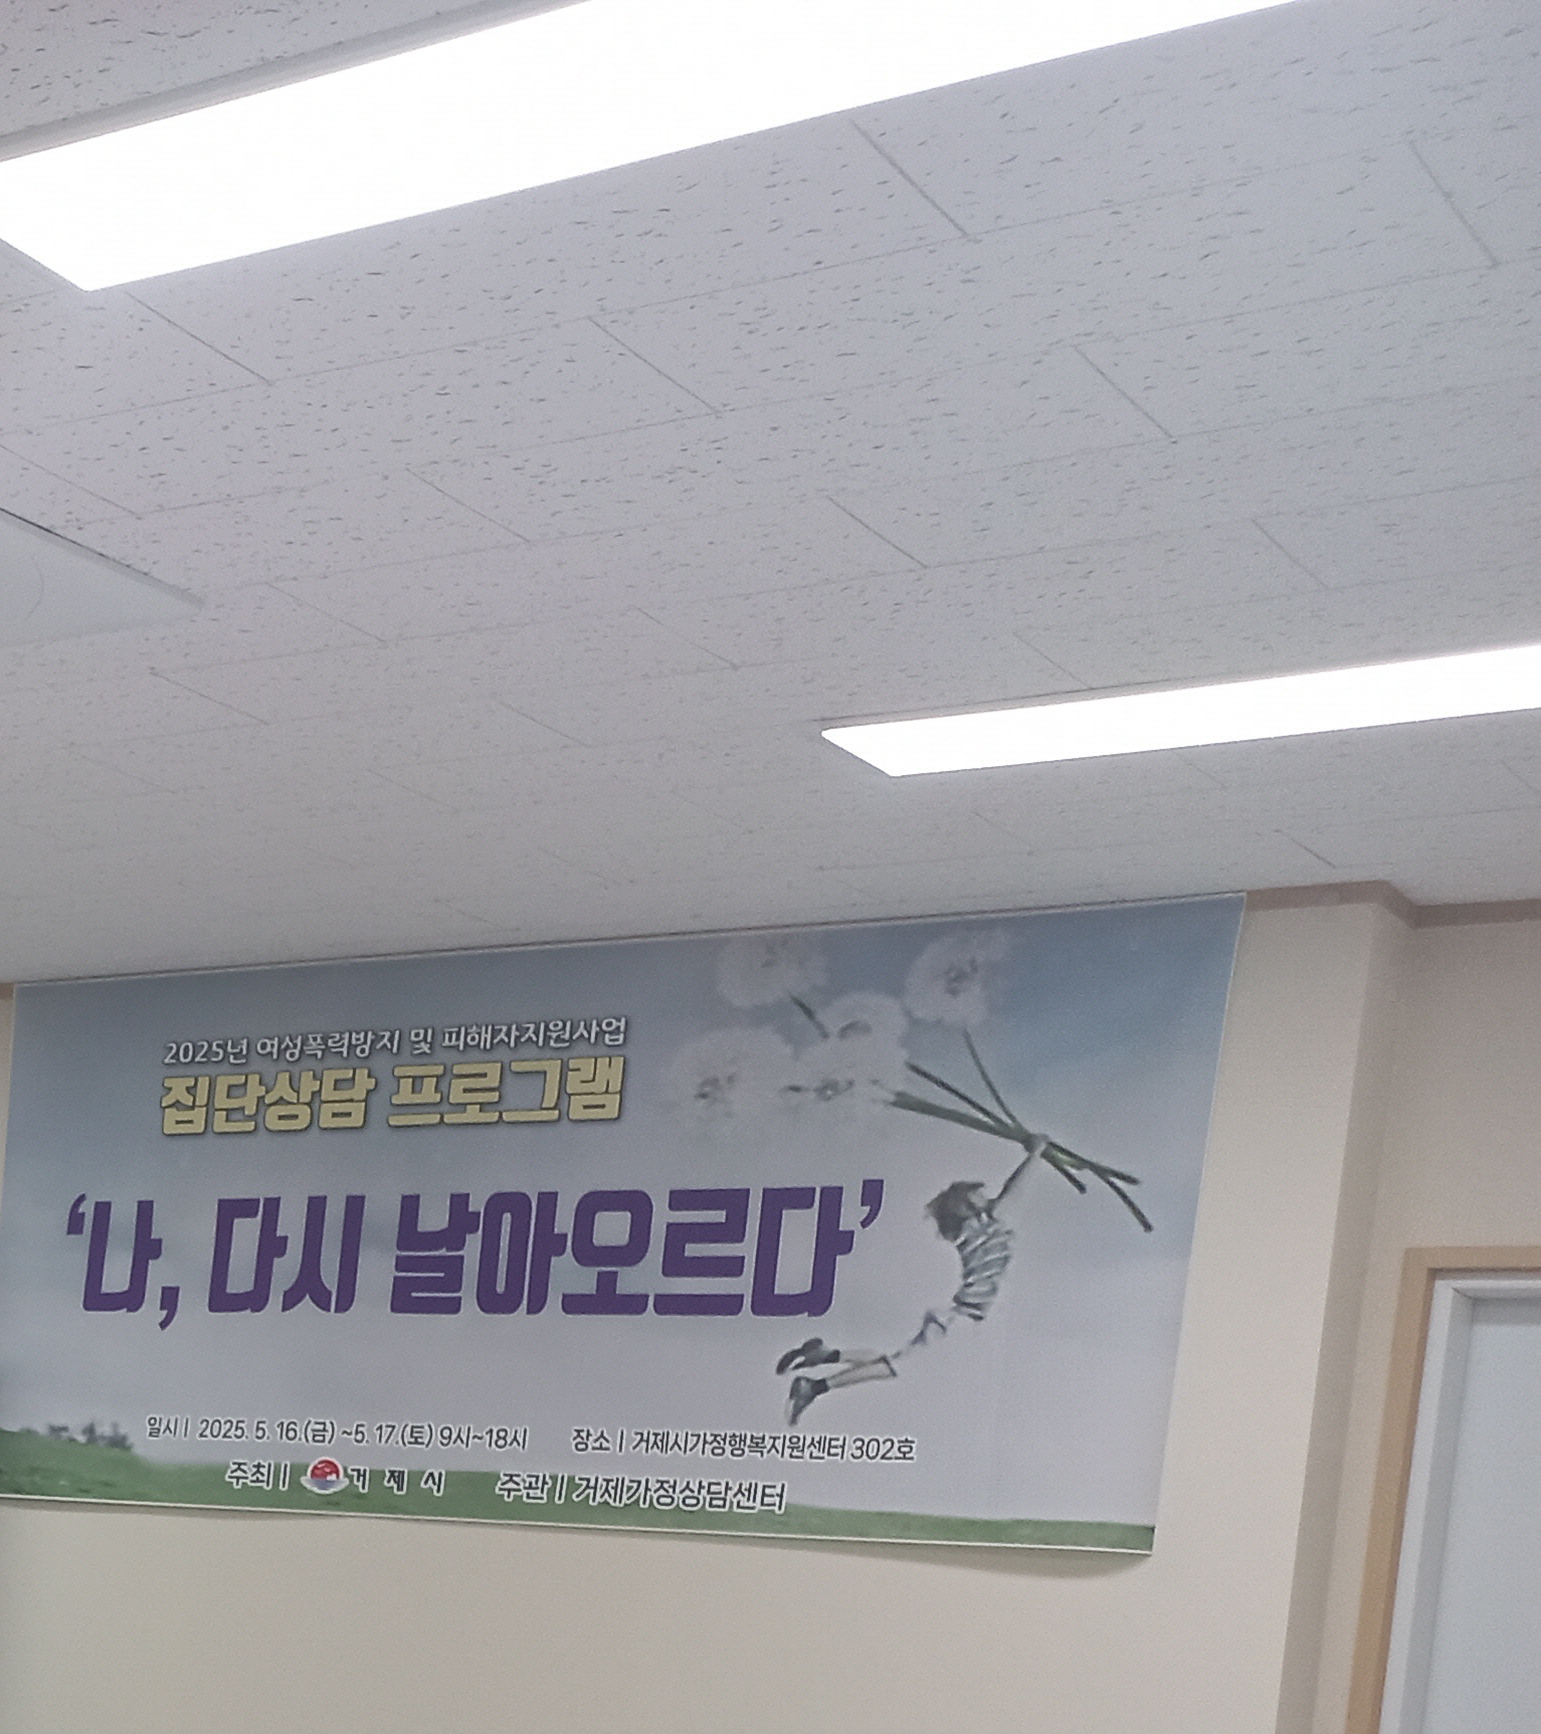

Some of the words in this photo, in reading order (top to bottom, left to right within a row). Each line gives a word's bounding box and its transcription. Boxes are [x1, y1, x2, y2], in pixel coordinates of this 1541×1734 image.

[163, 1036, 249, 1066] 2025년
[256, 1029, 401, 1061] 여성폭력방지
[409, 1027, 432, 1055] 및
[441, 1017, 628, 1053] 피해자지원사업
[160, 1067, 376, 1136] 집단상담
[387, 1056, 626, 1128] 프로그램
[207, 1194, 365, 1315] 다시
[572, 1428, 610, 1453] 장소
[851, 1437, 916, 1462] 302호
[228, 1461, 273, 1489] 주최
[497, 1472, 549, 1502] 주관
[574, 1476, 787, 1513] 거제가정상담센터
